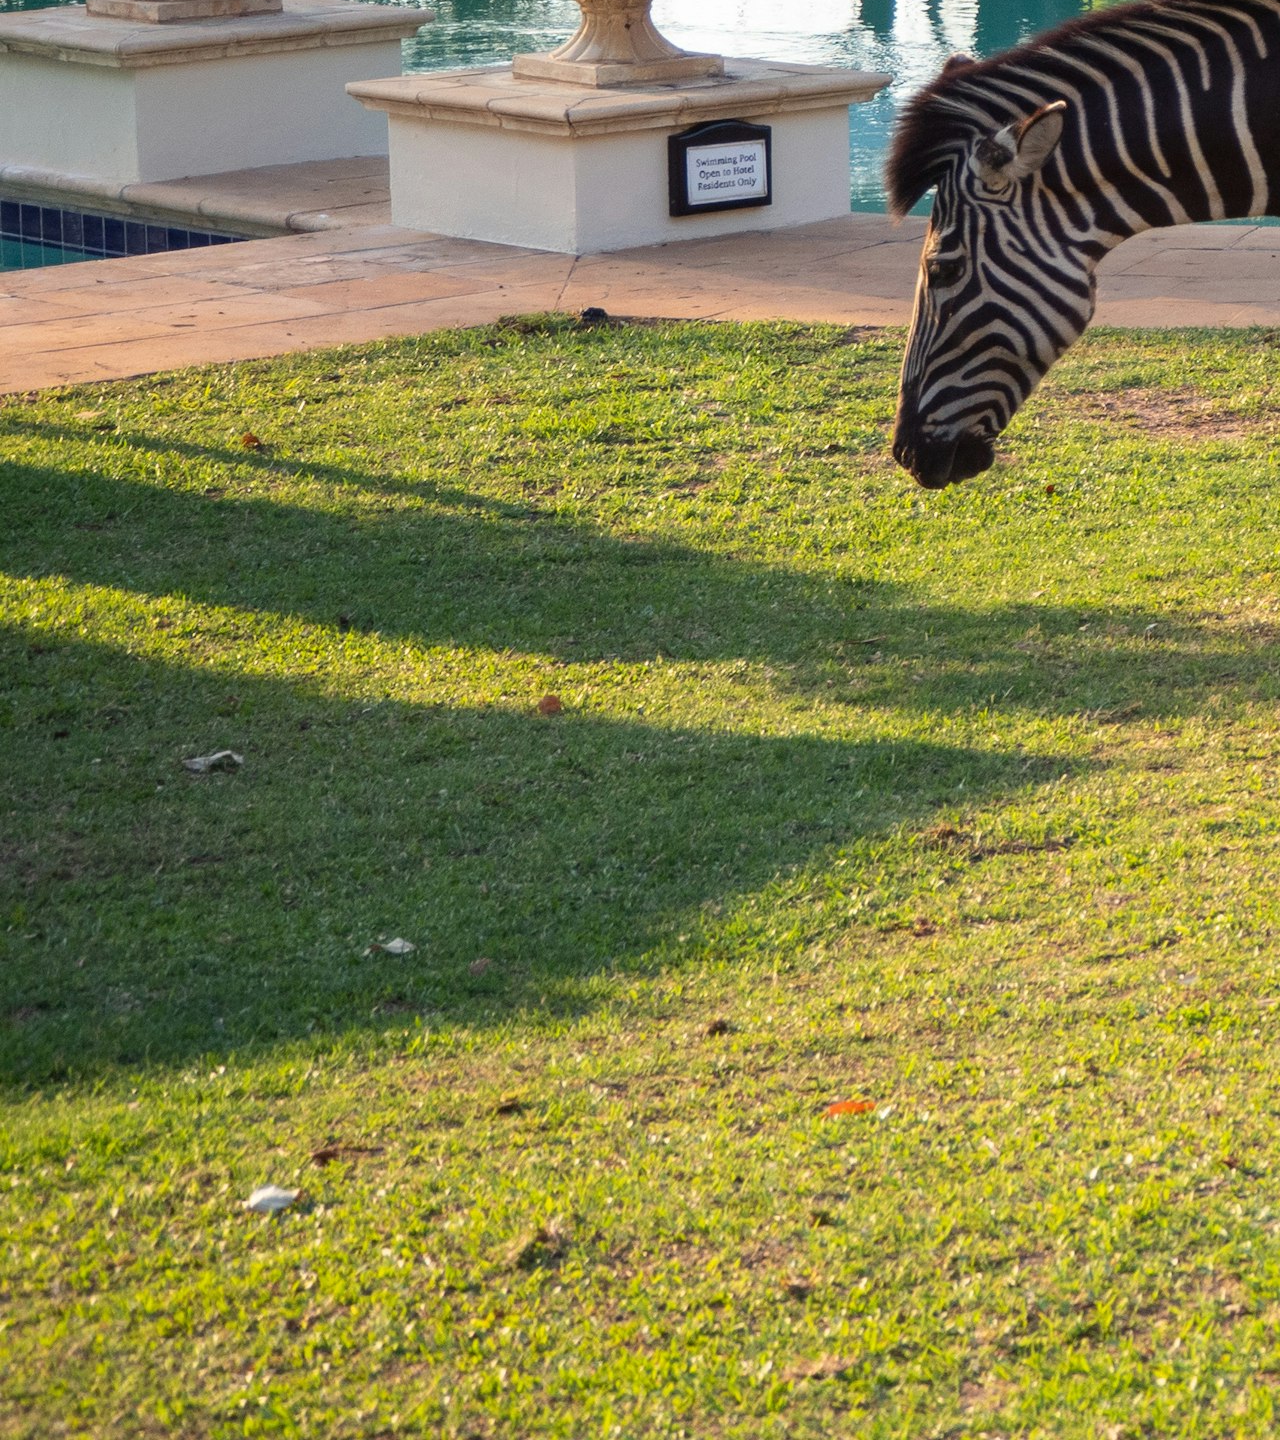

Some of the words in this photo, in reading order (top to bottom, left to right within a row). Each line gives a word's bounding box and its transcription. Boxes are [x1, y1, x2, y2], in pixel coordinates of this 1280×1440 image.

[696, 156, 738, 167] Swimming
[740, 153, 757, 163] Pool
[699, 170, 721, 180] Open
[733, 165, 754, 175] Hotel
[698, 180, 736, 191] Residents
[737, 178, 757, 187] Only
